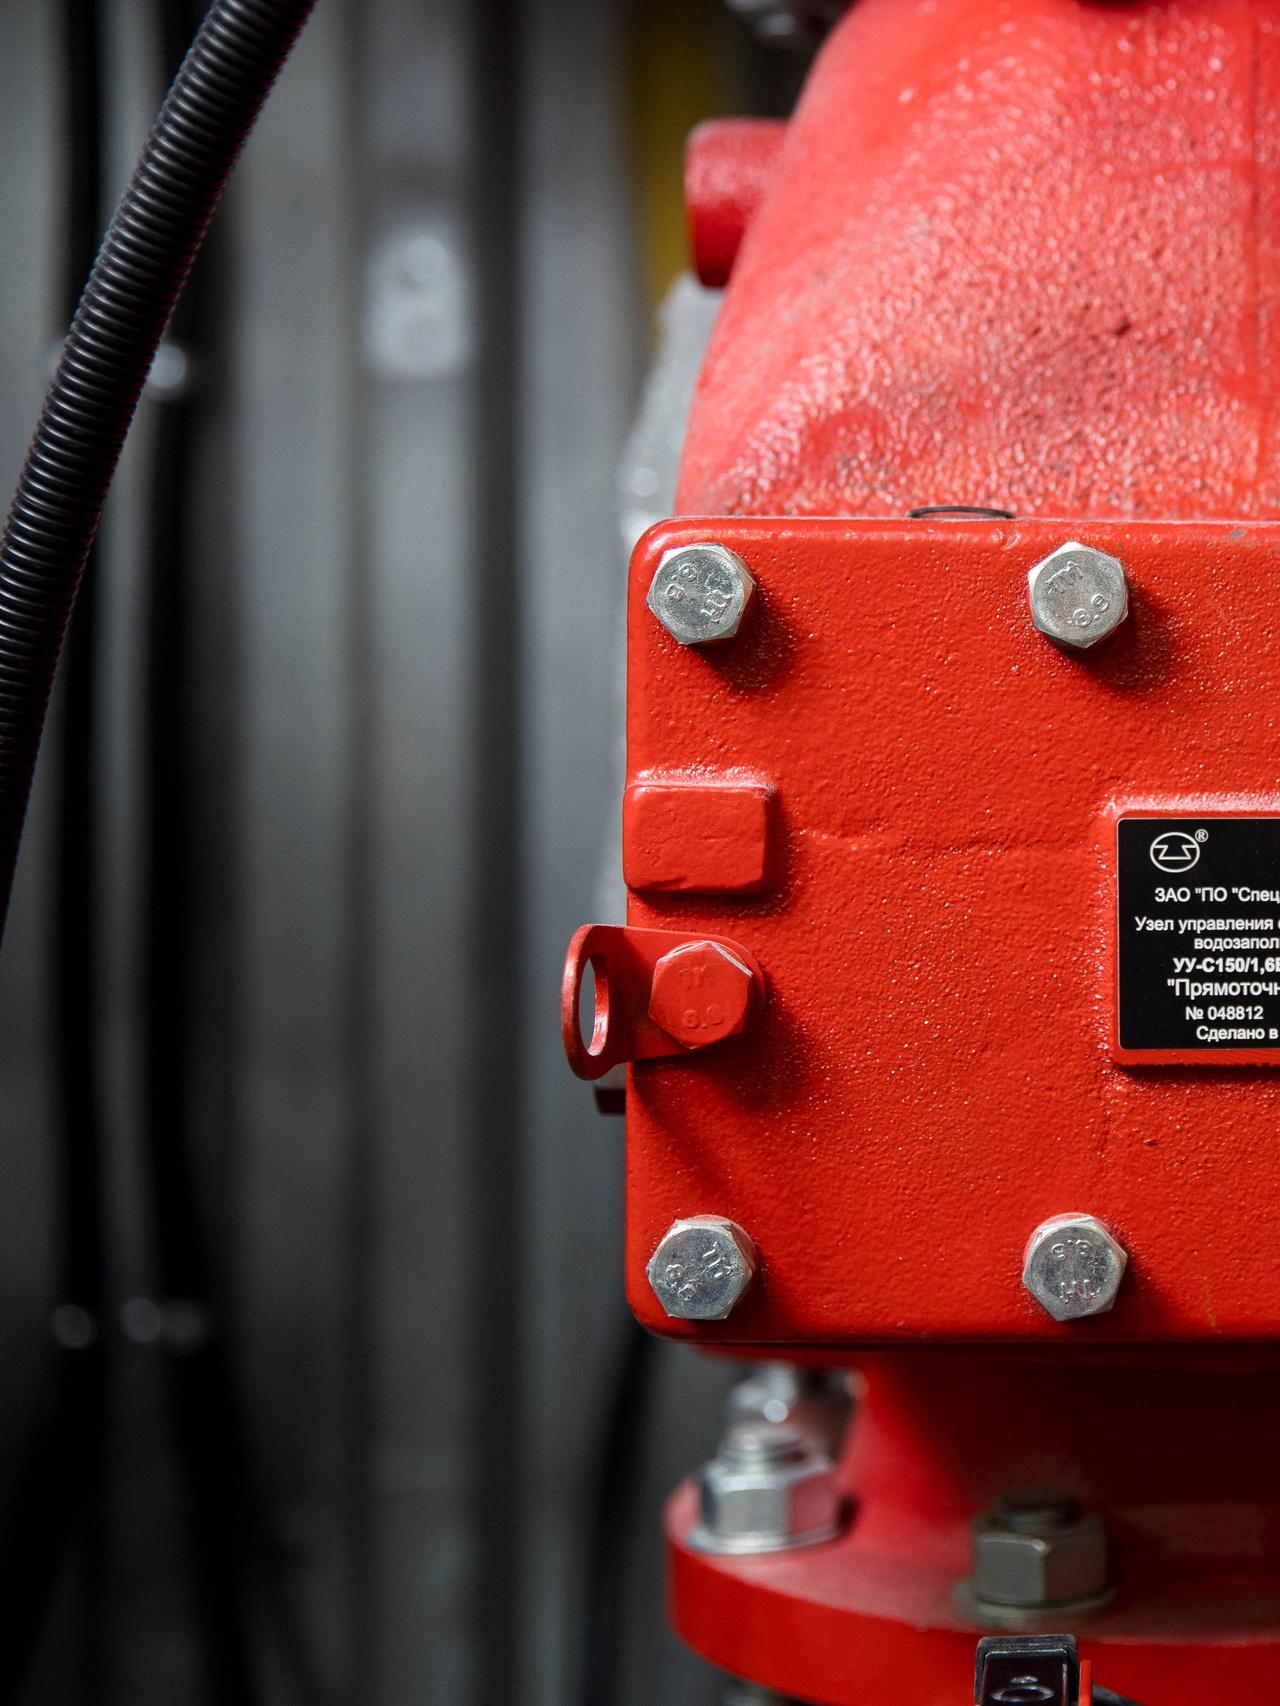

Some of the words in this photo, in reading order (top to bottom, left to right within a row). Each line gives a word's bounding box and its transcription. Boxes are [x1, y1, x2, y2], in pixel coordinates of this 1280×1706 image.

[1155, 887, 1190, 902] ЗАО
[1195, 887, 1227, 902] "ПО
[1135, 917, 1174, 931] Узел
[1178, 919, 1273, 934] управления
[1186, 1007, 1203, 1020] №
[1208, 1006, 1263, 1020] 048812
[1196, 1026, 1265, 1042] Сделано
[1269, 1028, 1278, 1039] в
